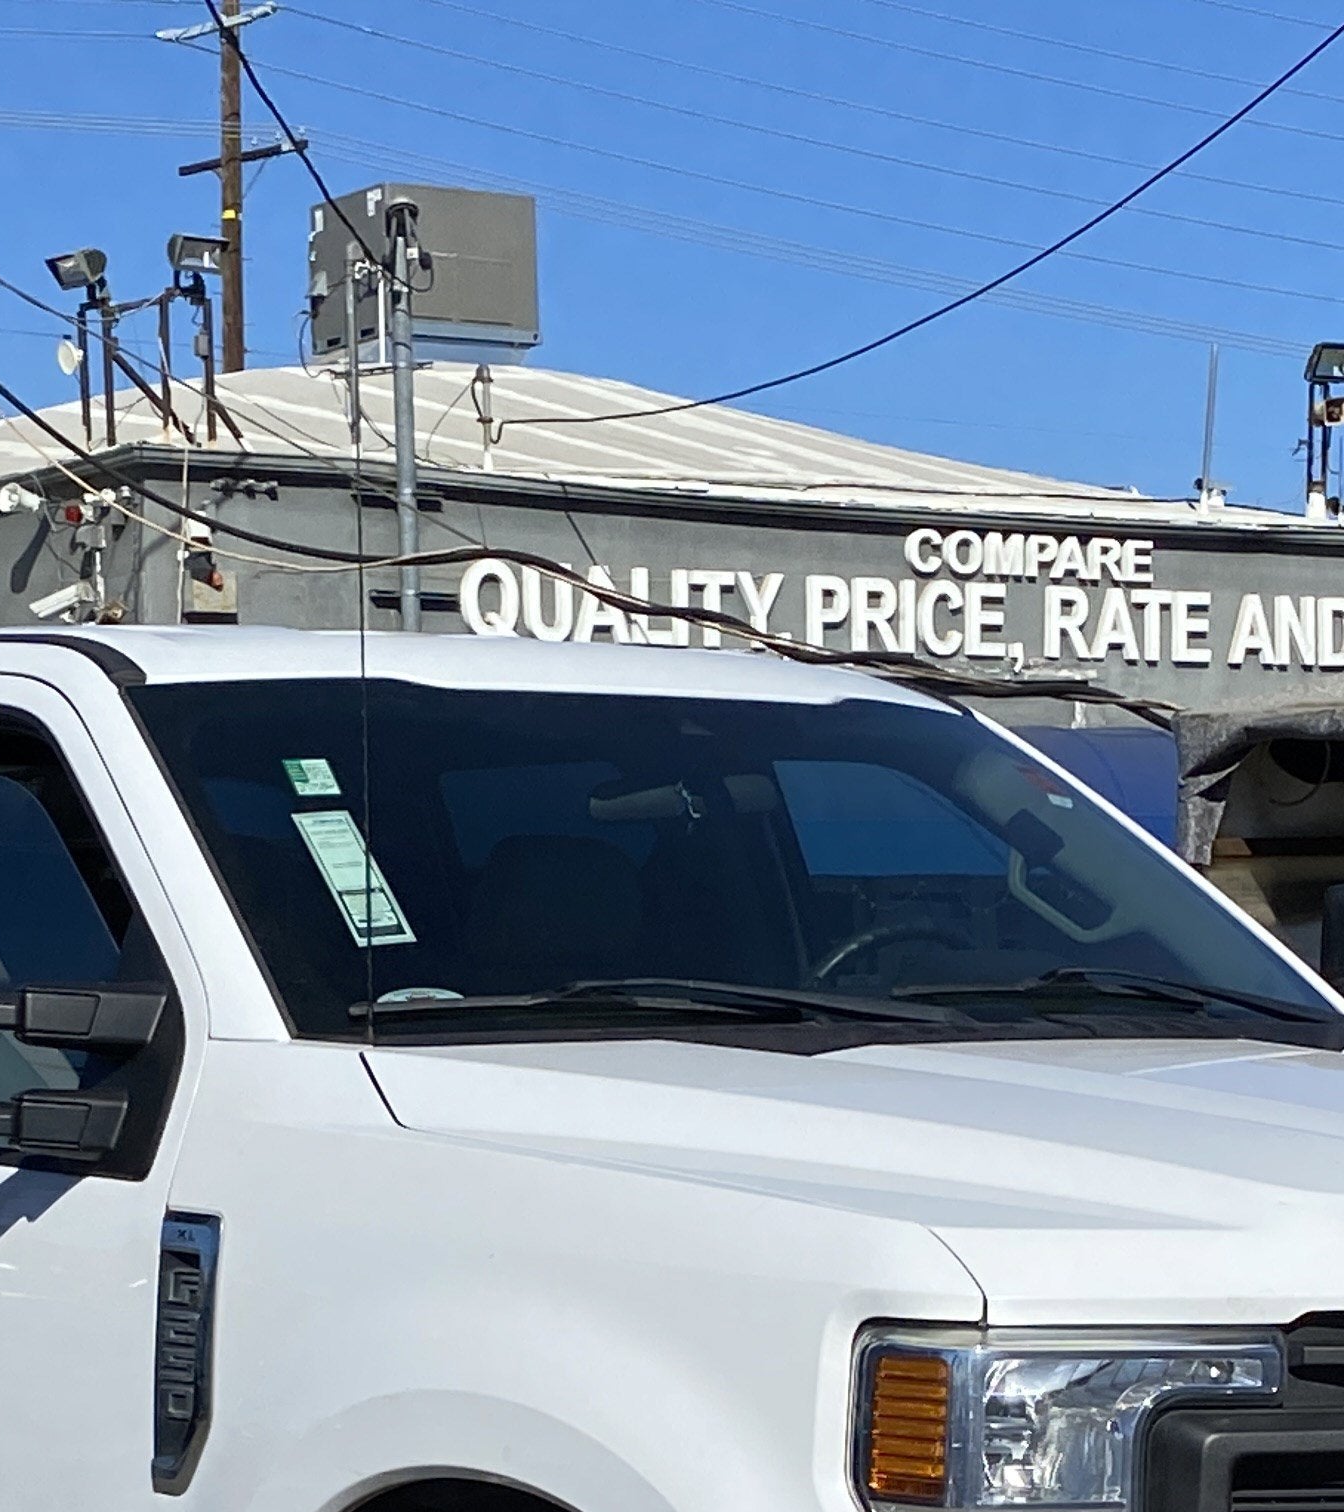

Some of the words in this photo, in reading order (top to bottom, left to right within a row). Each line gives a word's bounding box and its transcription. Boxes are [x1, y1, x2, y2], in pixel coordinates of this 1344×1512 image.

[904, 528, 1154, 582] COMPARE
[805, 574, 1025, 674] PRICE,
[1044, 584, 1212, 664] RATE
[176, 1228, 197, 1242] XL
